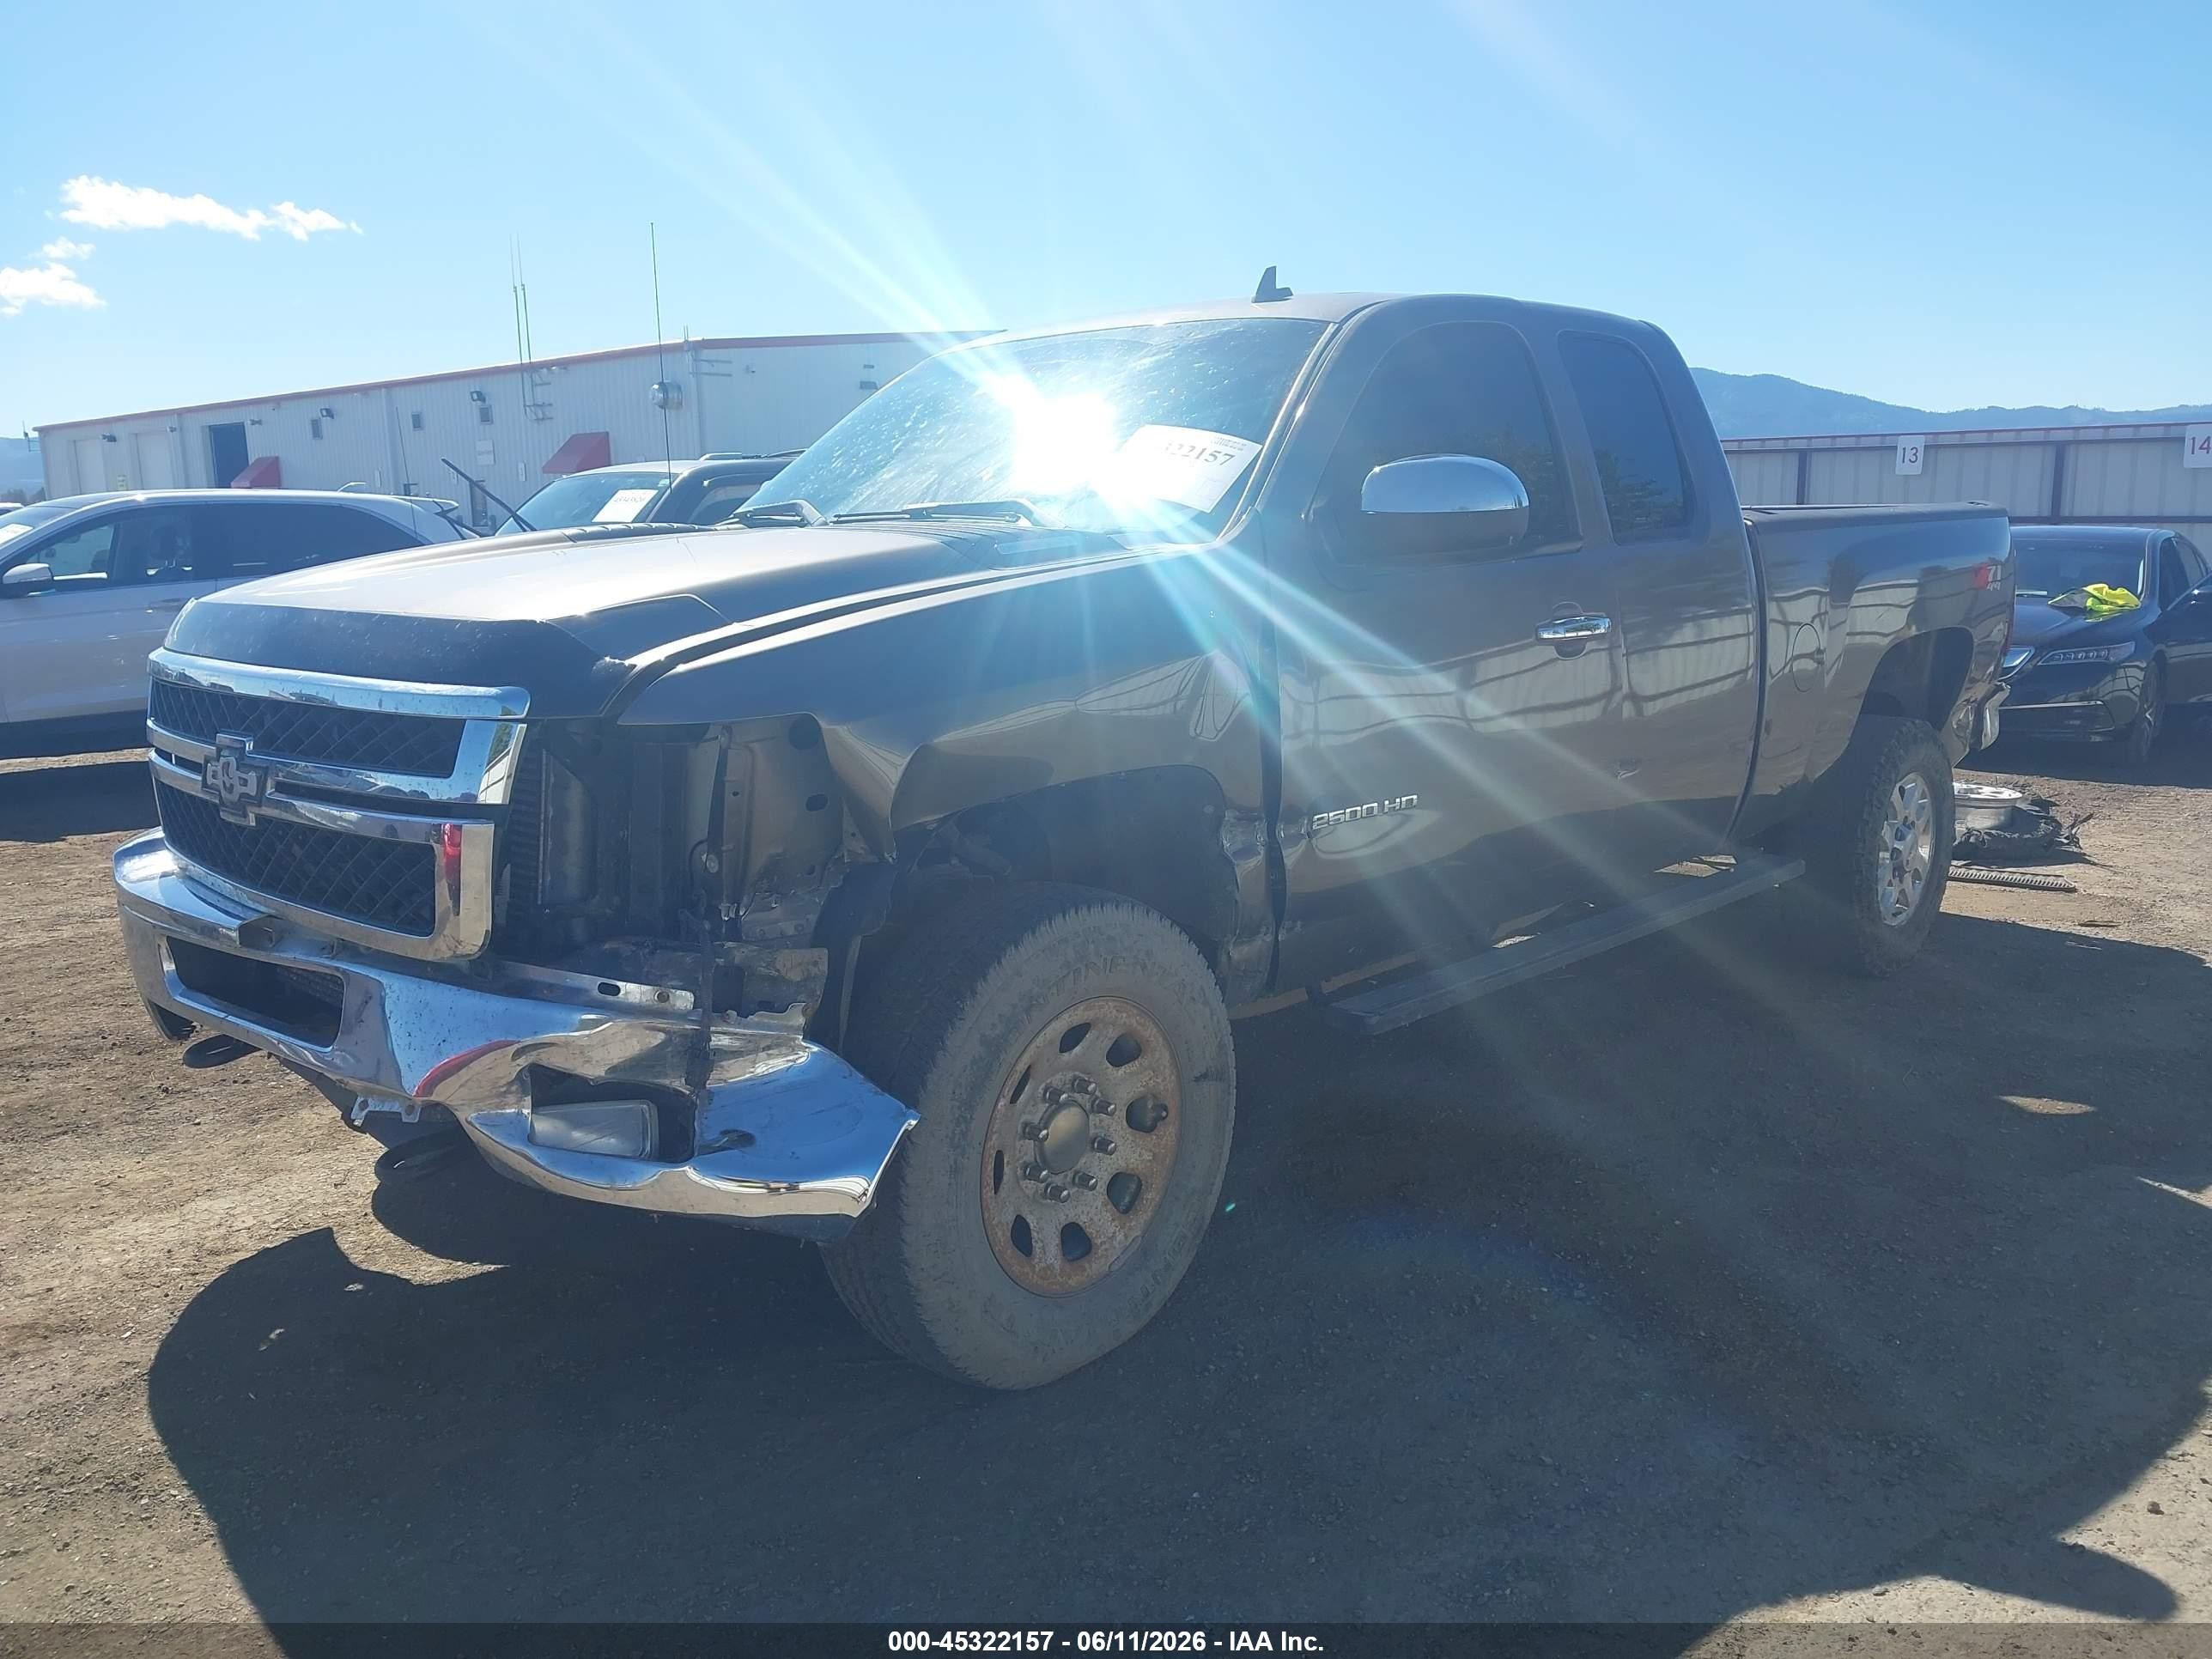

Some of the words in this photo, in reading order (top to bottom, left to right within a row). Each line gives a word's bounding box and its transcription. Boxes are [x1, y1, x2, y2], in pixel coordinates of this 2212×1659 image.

[1901, 446, 1918, 464] 13
[2191, 435, 2212, 455] 14
[1312, 802, 1378, 830] 2500
[1383, 794, 1418, 813] HD
